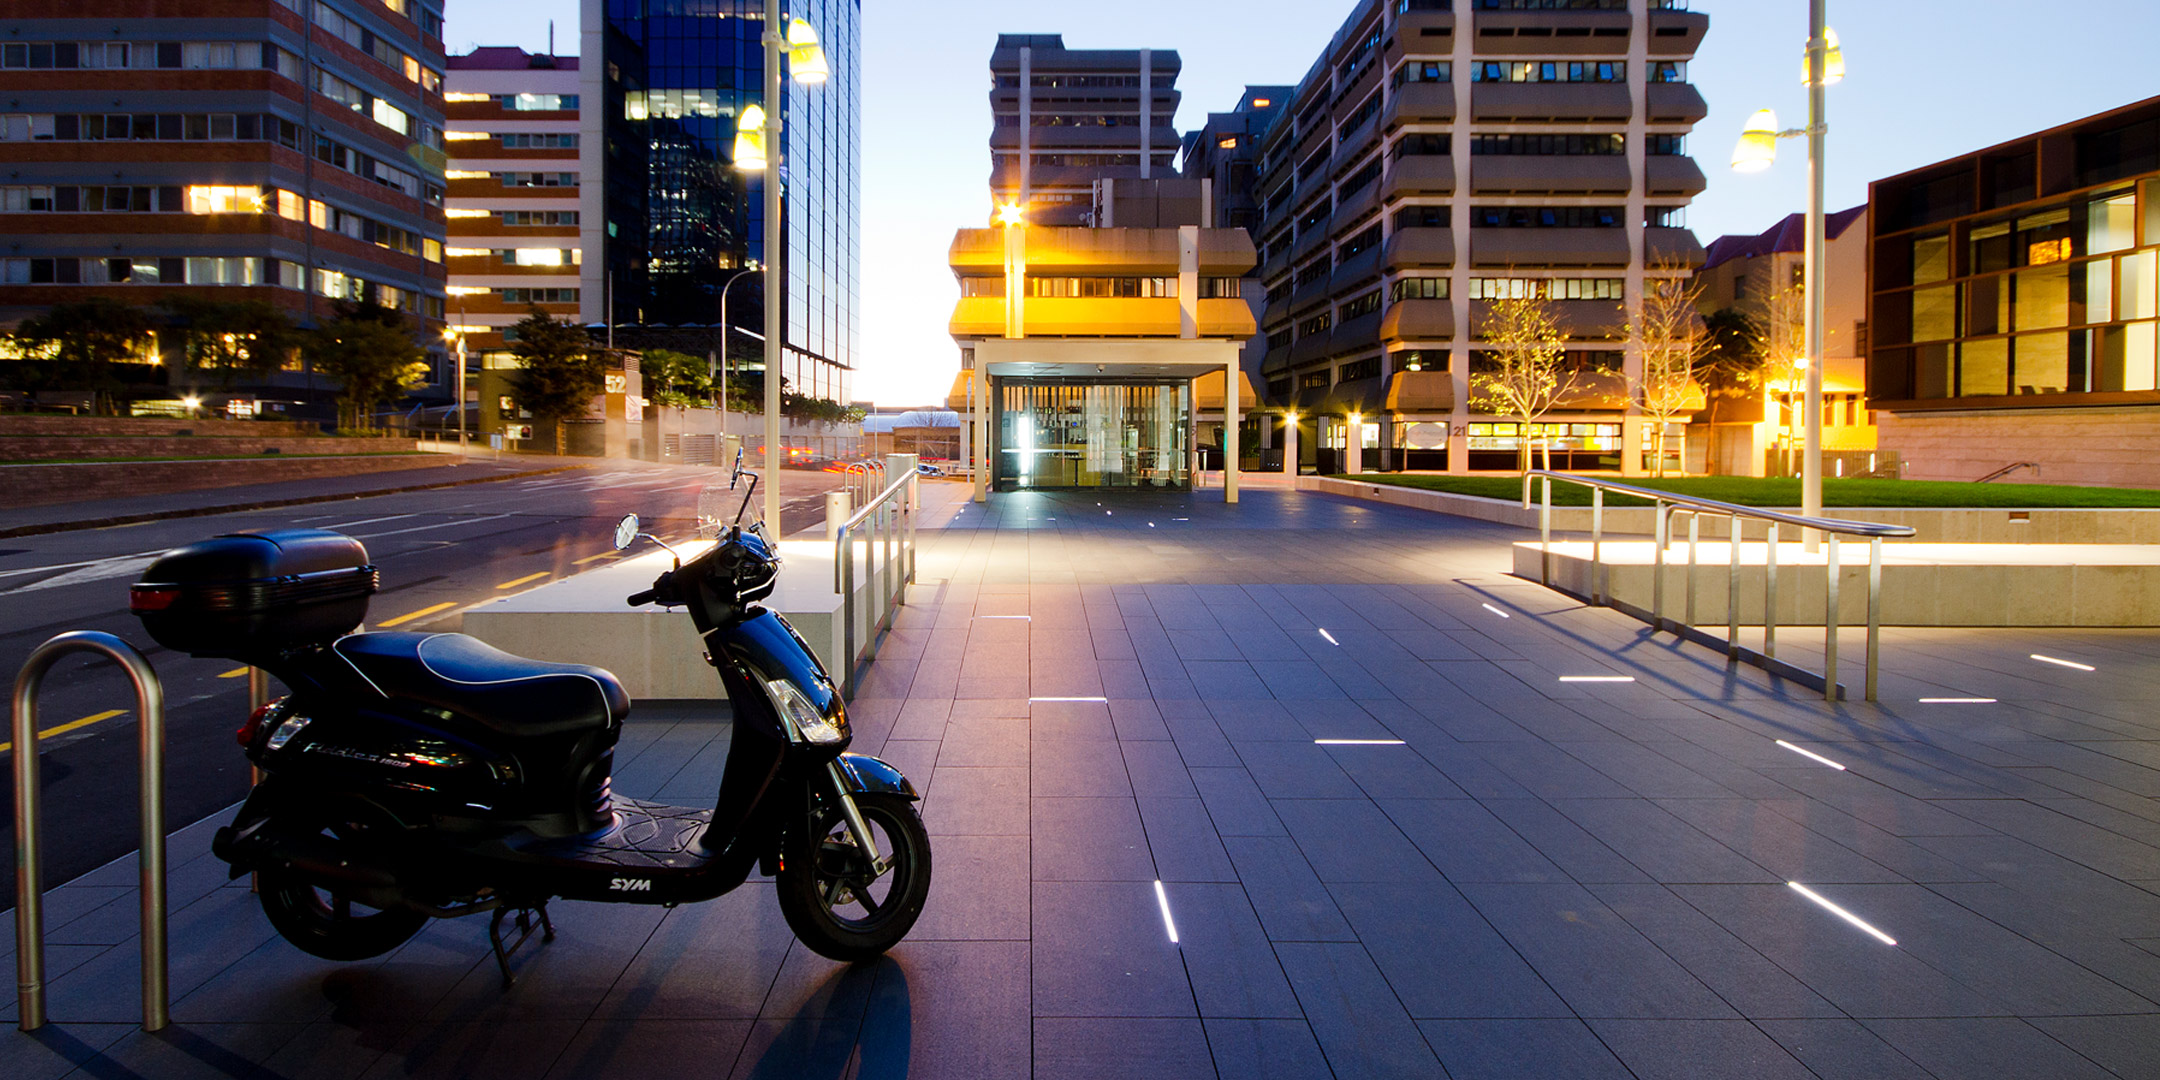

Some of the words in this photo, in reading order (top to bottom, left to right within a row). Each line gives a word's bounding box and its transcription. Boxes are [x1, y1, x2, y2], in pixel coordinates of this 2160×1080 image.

[605, 374, 626, 394] 52
[1453, 426, 1466, 437] 21
[609, 877, 651, 891] SYM
